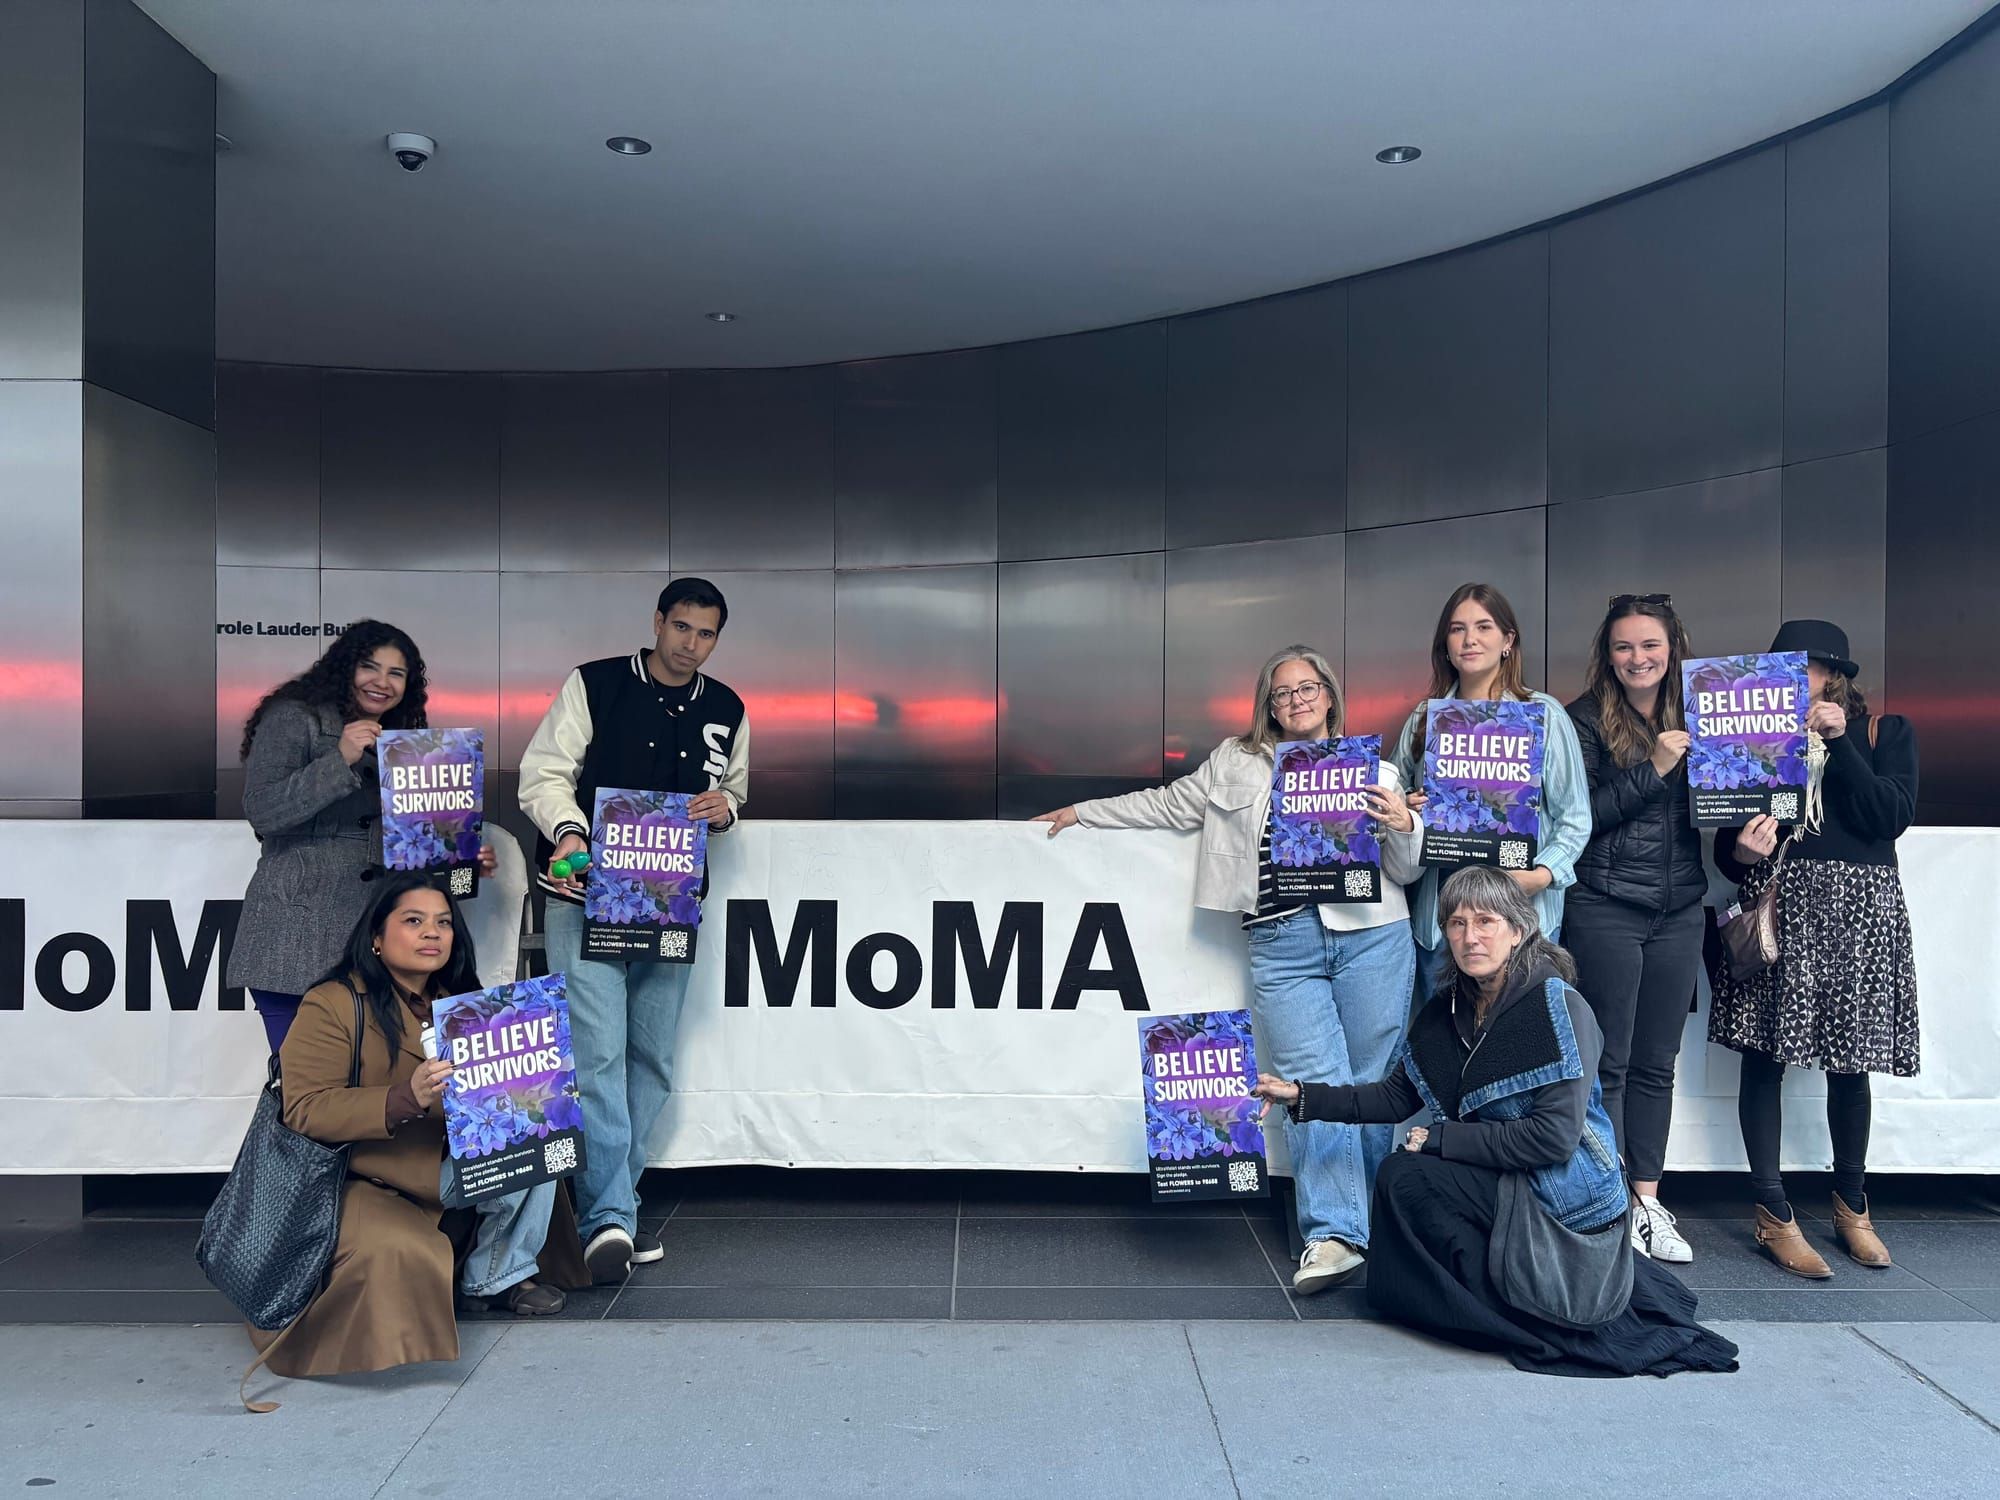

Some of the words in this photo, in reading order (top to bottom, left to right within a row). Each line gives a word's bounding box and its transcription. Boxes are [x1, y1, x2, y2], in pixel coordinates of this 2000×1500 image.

[257, 622, 320, 636] Lauder
[1698, 686, 1795, 714] BELIEVE
[1697, 713, 1798, 737] SURVIVORS
[1440, 733, 1530, 760] BELIEVE
[392, 763, 473, 790] BELIEVE
[1284, 766, 1366, 793] BELIEVE
[1436, 758, 1532, 782] SURVIVORS
[392, 790, 475, 814] SURVIVORS
[1281, 792, 1368, 814] SURVIVORS
[605, 823, 694, 850] BELIEVE
[601, 849, 694, 873] SURVIVORS
[0, 898, 259, 1012] oM
[724, 898, 1150, 1011] MoMA
[452, 1016, 556, 1065] BELIEVE
[452, 1046, 562, 1094] SURVIVORS
[1154, 1048, 1242, 1077] BELIEVE
[1154, 1076, 1249, 1102] SURVIVORS
[487, 1158, 503, 1166] stands
[503, 1153, 514, 1161] with
[463, 1182, 477, 1191] Text
[478, 1172, 507, 1186] FLOWERS
